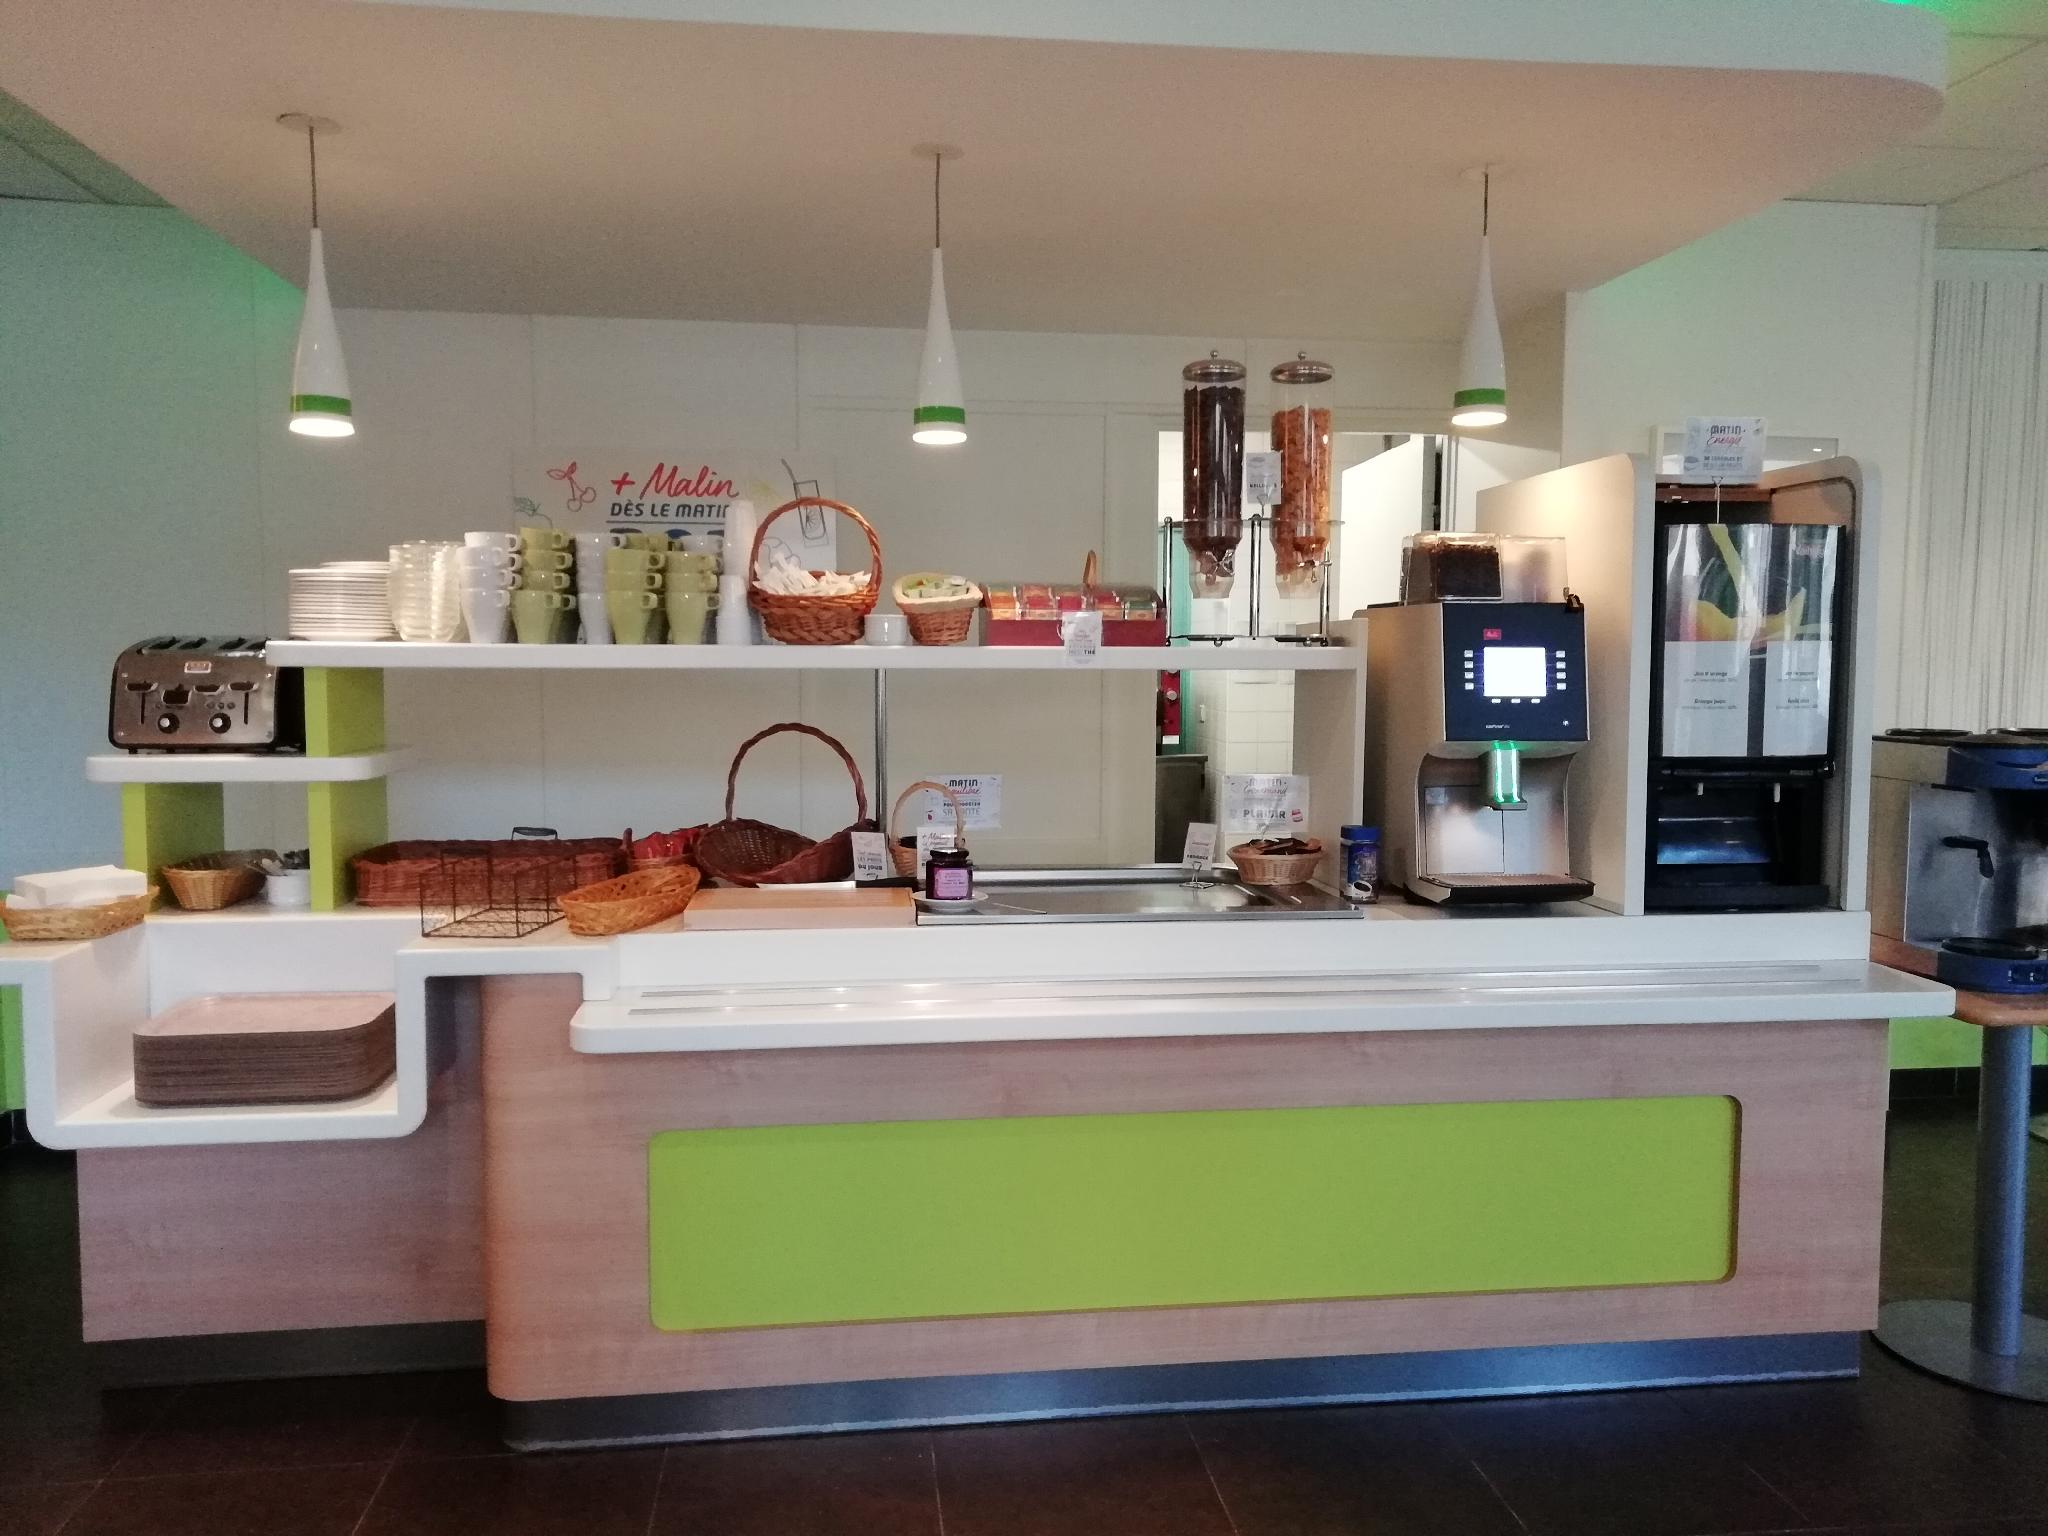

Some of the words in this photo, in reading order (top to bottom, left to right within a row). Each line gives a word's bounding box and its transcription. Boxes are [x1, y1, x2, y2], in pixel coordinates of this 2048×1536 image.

[639, 462, 740, 501] Malin
[610, 499, 645, 518] DÈS
[650, 503, 671, 518] LE
[949, 779, 978, 787] MATIN
